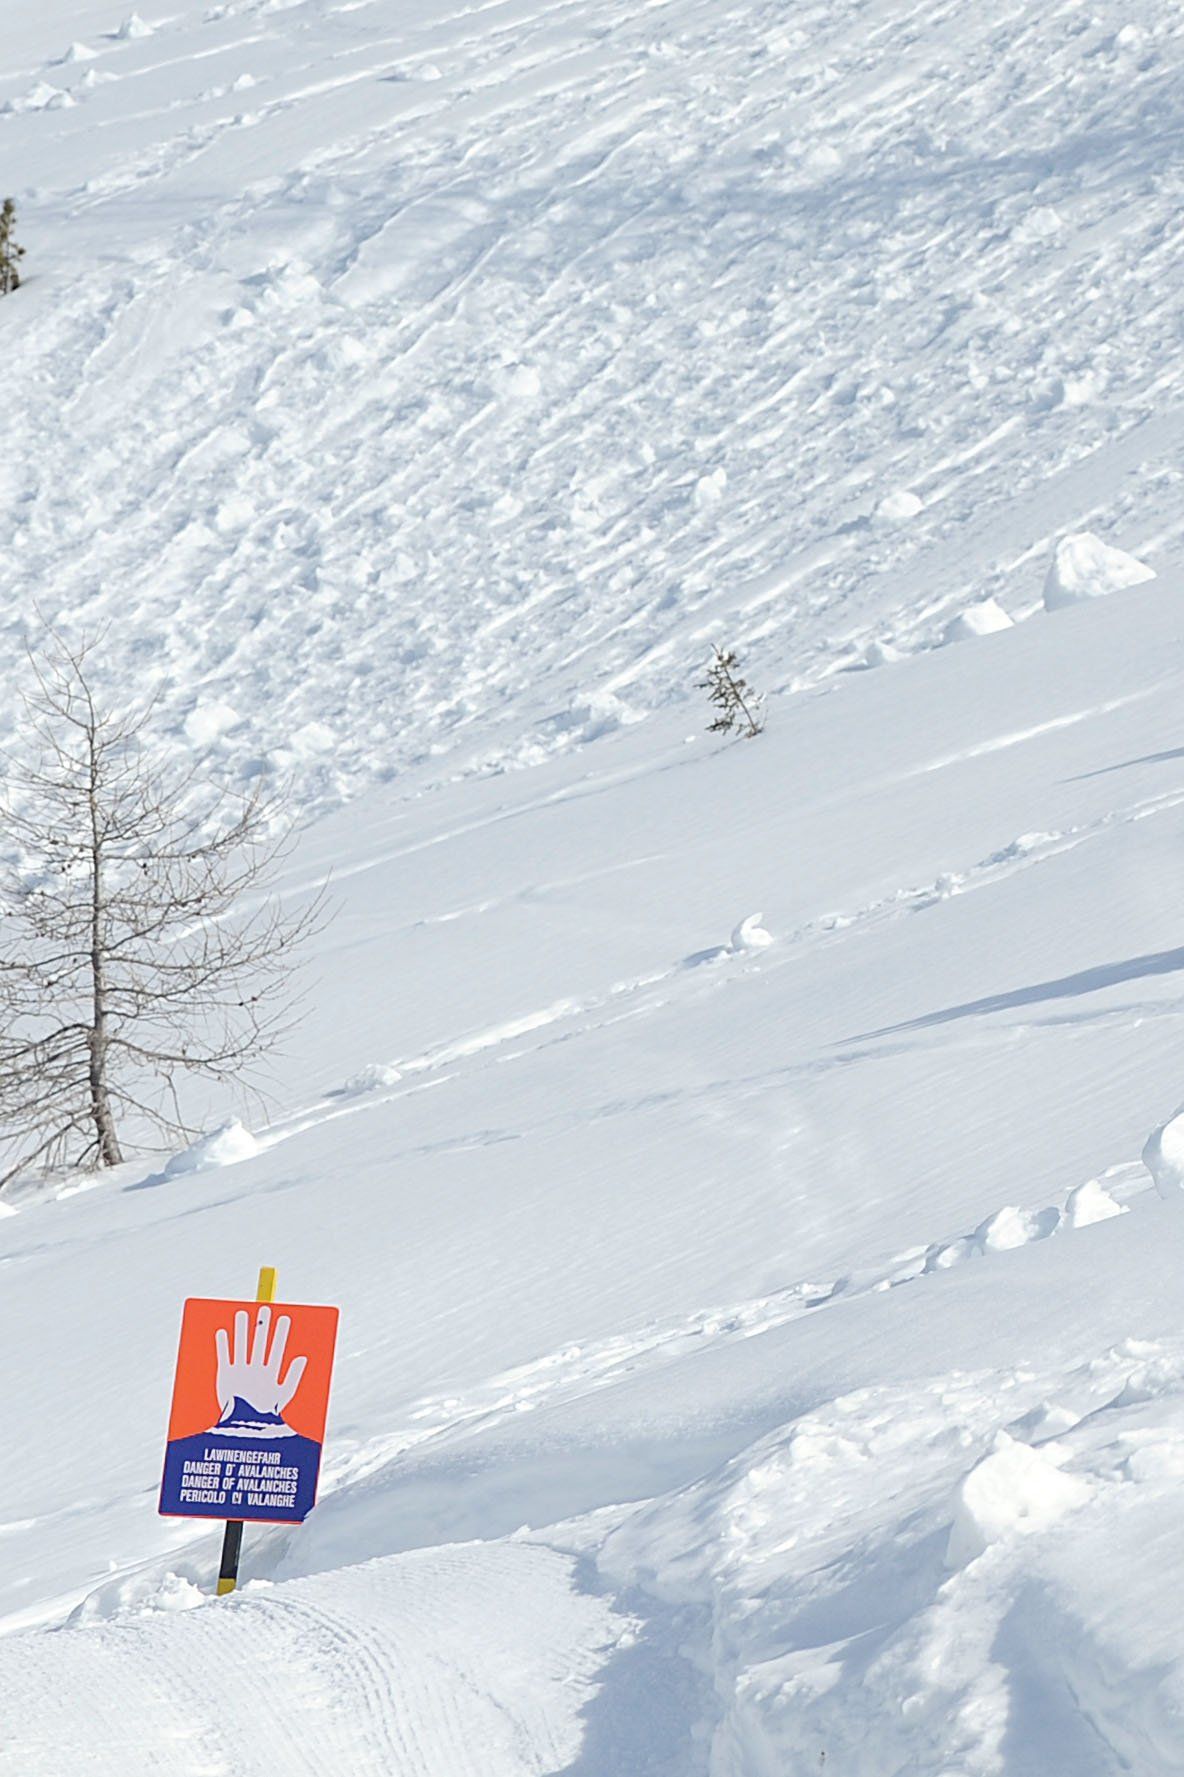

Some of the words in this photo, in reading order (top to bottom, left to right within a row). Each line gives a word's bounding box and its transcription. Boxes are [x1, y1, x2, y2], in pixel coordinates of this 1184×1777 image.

[204, 1448, 281, 1465] LAWINENGEFAHR
[183, 1461, 221, 1475] DANGER
[238, 1465, 299, 1480] AVALANCHES
[181, 1475, 219, 1489] DANGER
[222, 1478, 235, 1490] OF
[236, 1479, 297, 1493] AVALANCHES
[180, 1489, 226, 1504] PERICOLO
[247, 1494, 295, 1508] VALANGHE
